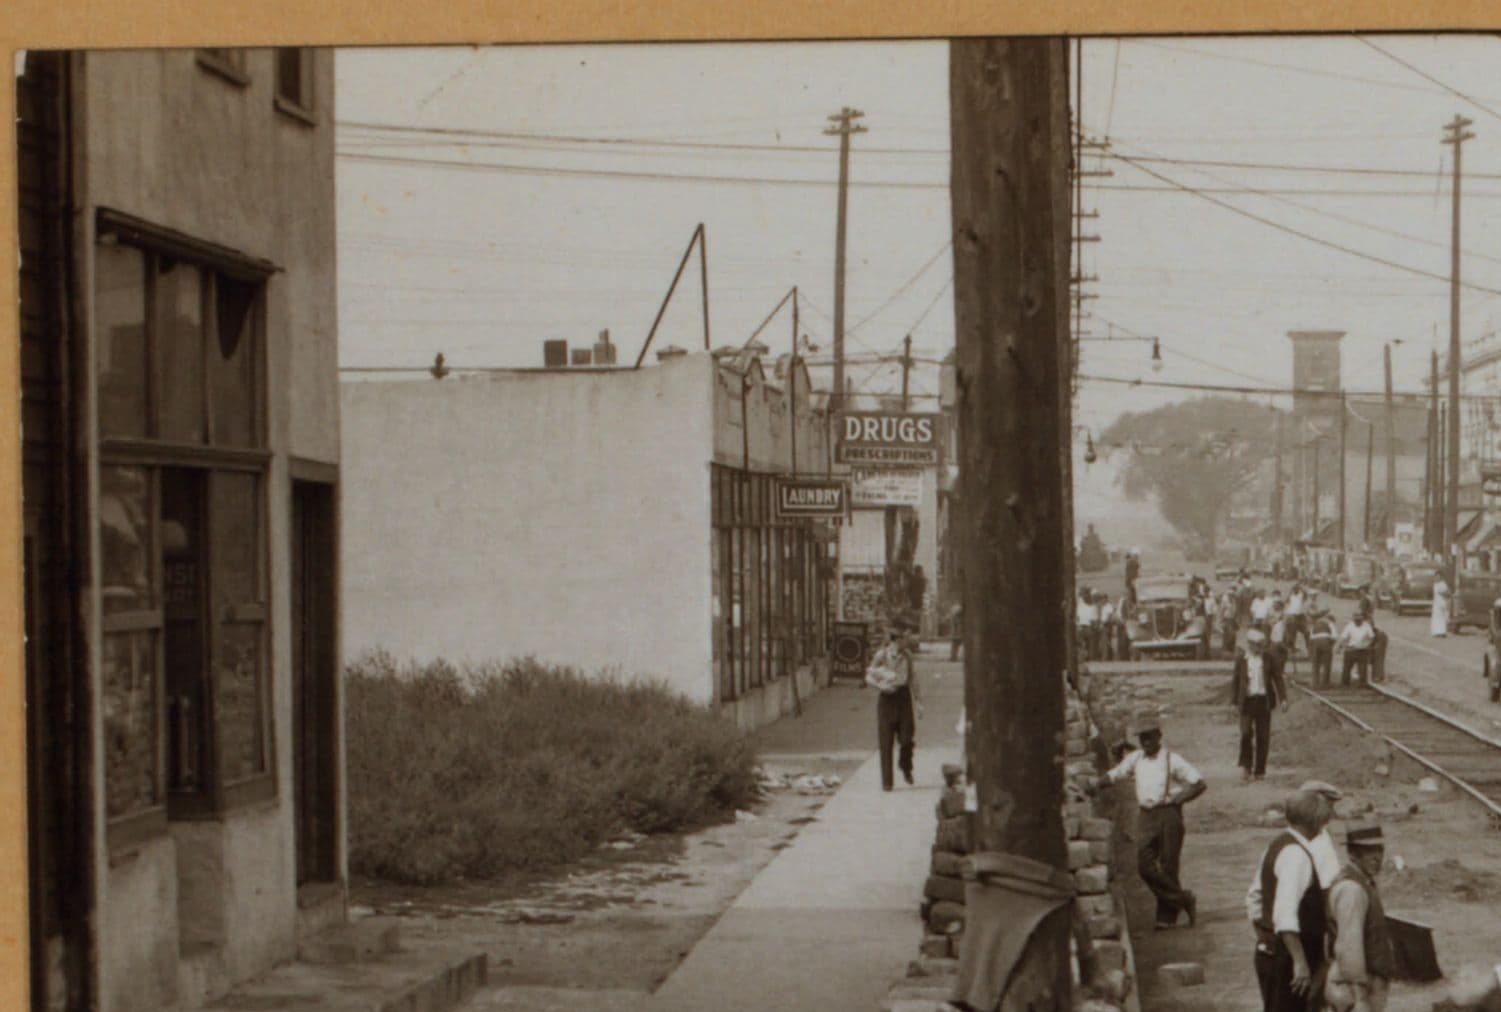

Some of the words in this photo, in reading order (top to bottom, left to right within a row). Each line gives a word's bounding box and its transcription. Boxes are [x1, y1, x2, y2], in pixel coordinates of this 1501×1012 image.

[844, 415, 932, 442] DRUGS
[844, 448, 932, 460] PRESCRIPTIONS
[782, 486, 841, 508] LAUNDRY
